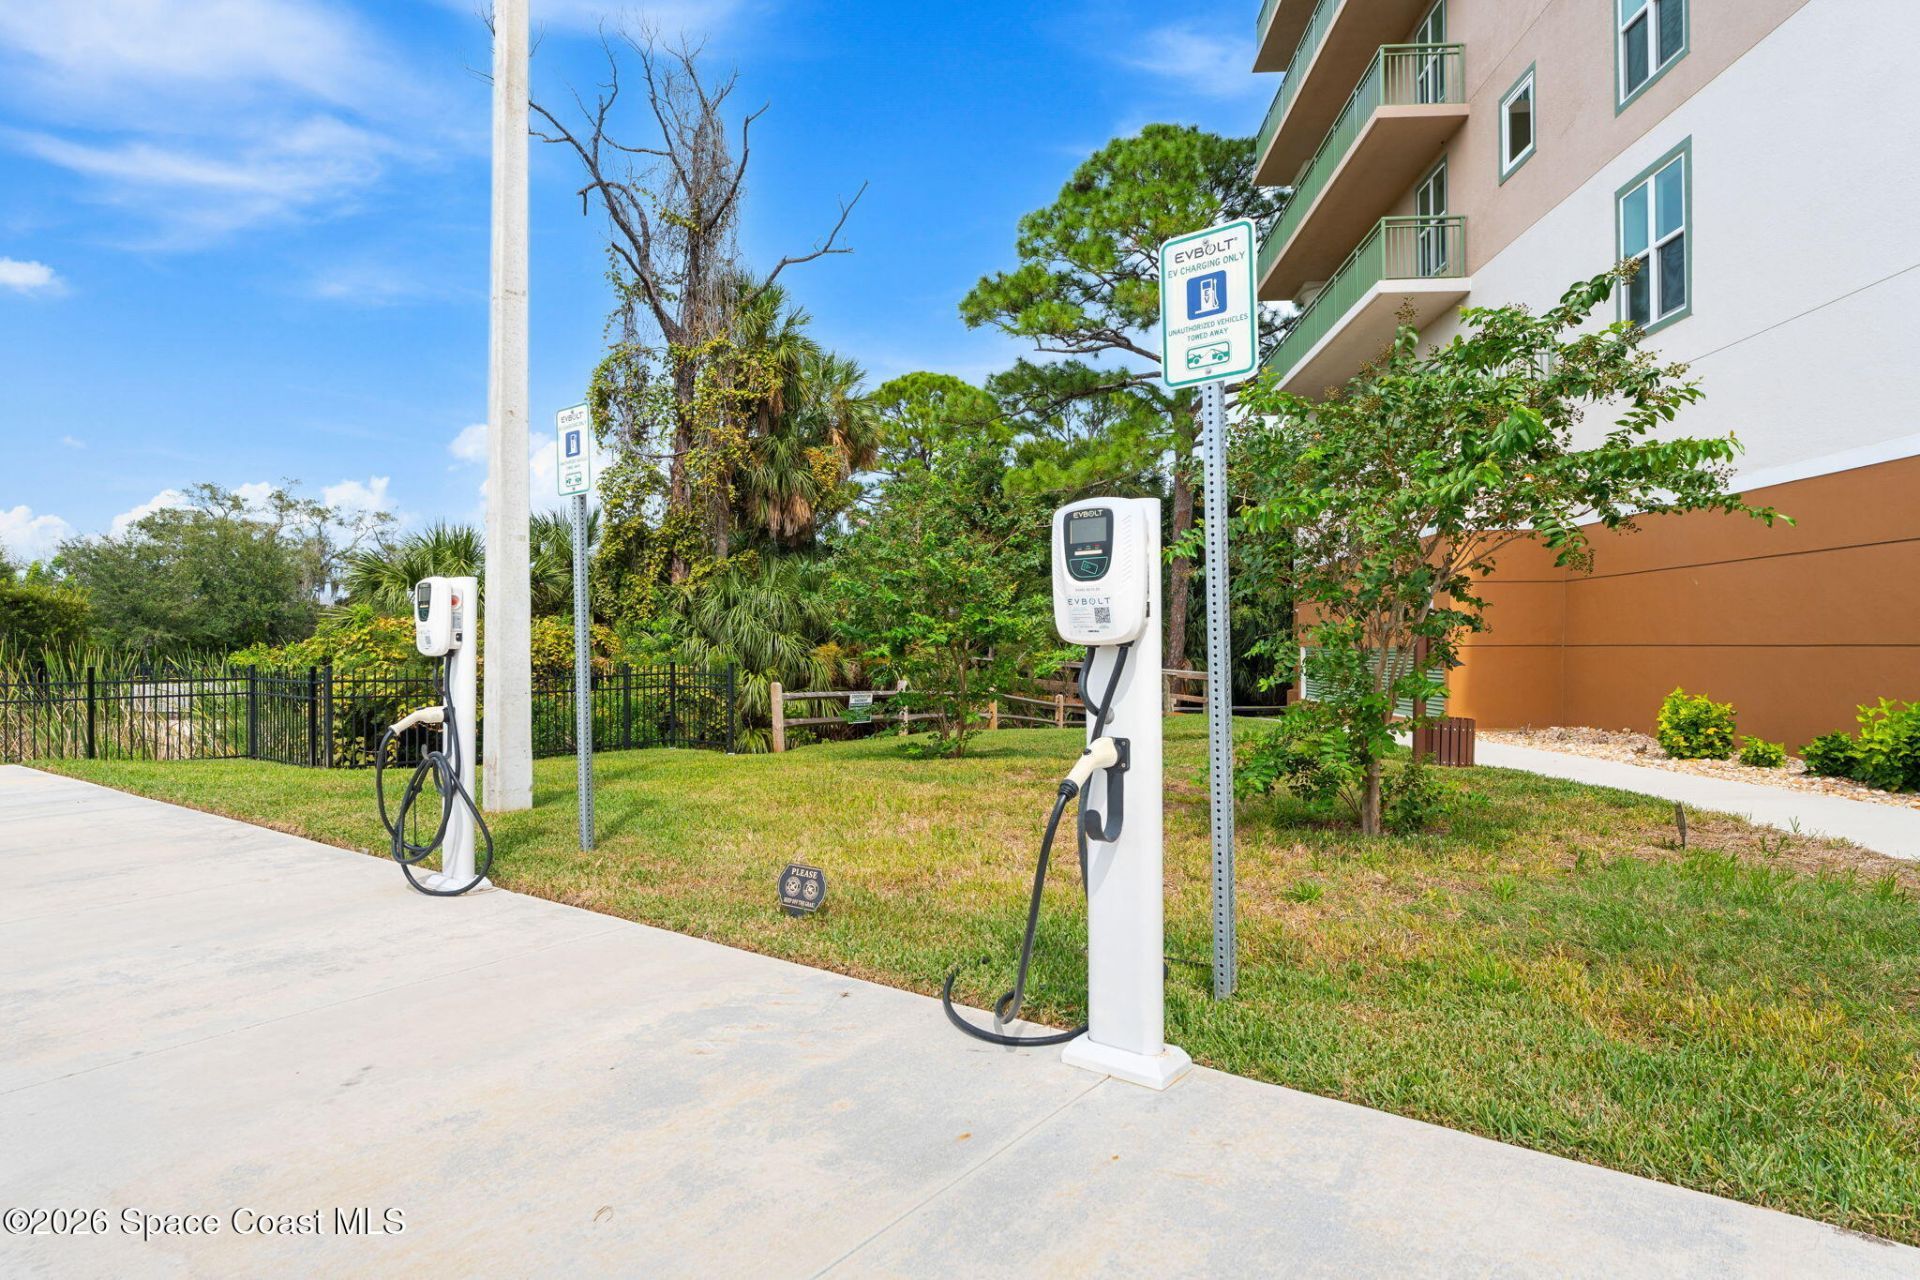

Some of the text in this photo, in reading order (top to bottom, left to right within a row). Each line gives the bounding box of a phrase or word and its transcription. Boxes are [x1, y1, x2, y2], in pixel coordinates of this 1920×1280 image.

[1168, 251, 1246, 279] EV CHARGING ONLY
[1168, 313, 1249, 337] UNAUTHORIZED VEHICLES
[1187, 327, 1230, 342] TOWED AWAY
[1073, 509, 1104, 519] EVBOLT
[1067, 596, 1111, 606] EVBOLT
[791, 867, 818, 880] PLEASE
